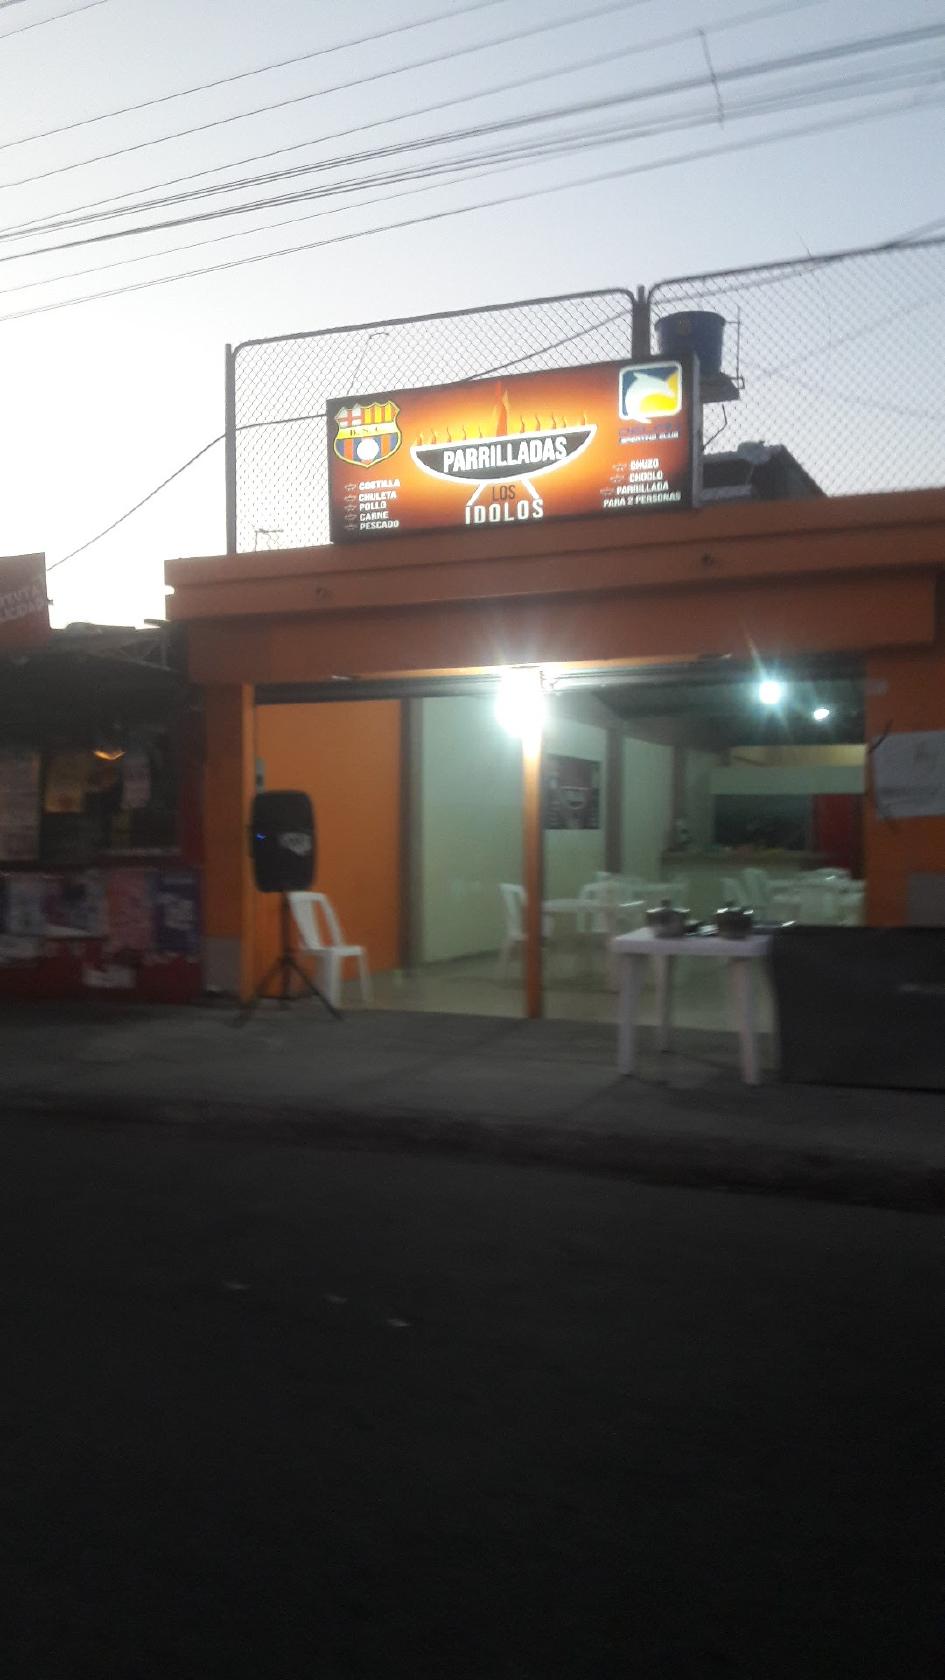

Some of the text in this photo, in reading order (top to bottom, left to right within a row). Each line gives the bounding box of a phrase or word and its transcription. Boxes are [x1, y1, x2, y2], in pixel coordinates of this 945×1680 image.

[443, 436, 568, 473] PARRILLADAS
[630, 458, 660, 471] CHUZO
[629, 470, 664, 483] CHOCLO
[359, 480, 401, 491] COSTILLA
[616, 481, 669, 495] PARRILLADA
[359, 491, 397, 502] CHULETA
[492, 484, 516, 501] LOS
[603, 491, 682, 508] PARA 2 PERSONAS
[360, 501, 387, 512] POLLO
[360, 511, 390, 522] CARNE
[360, 520, 400, 531] PESCADO
